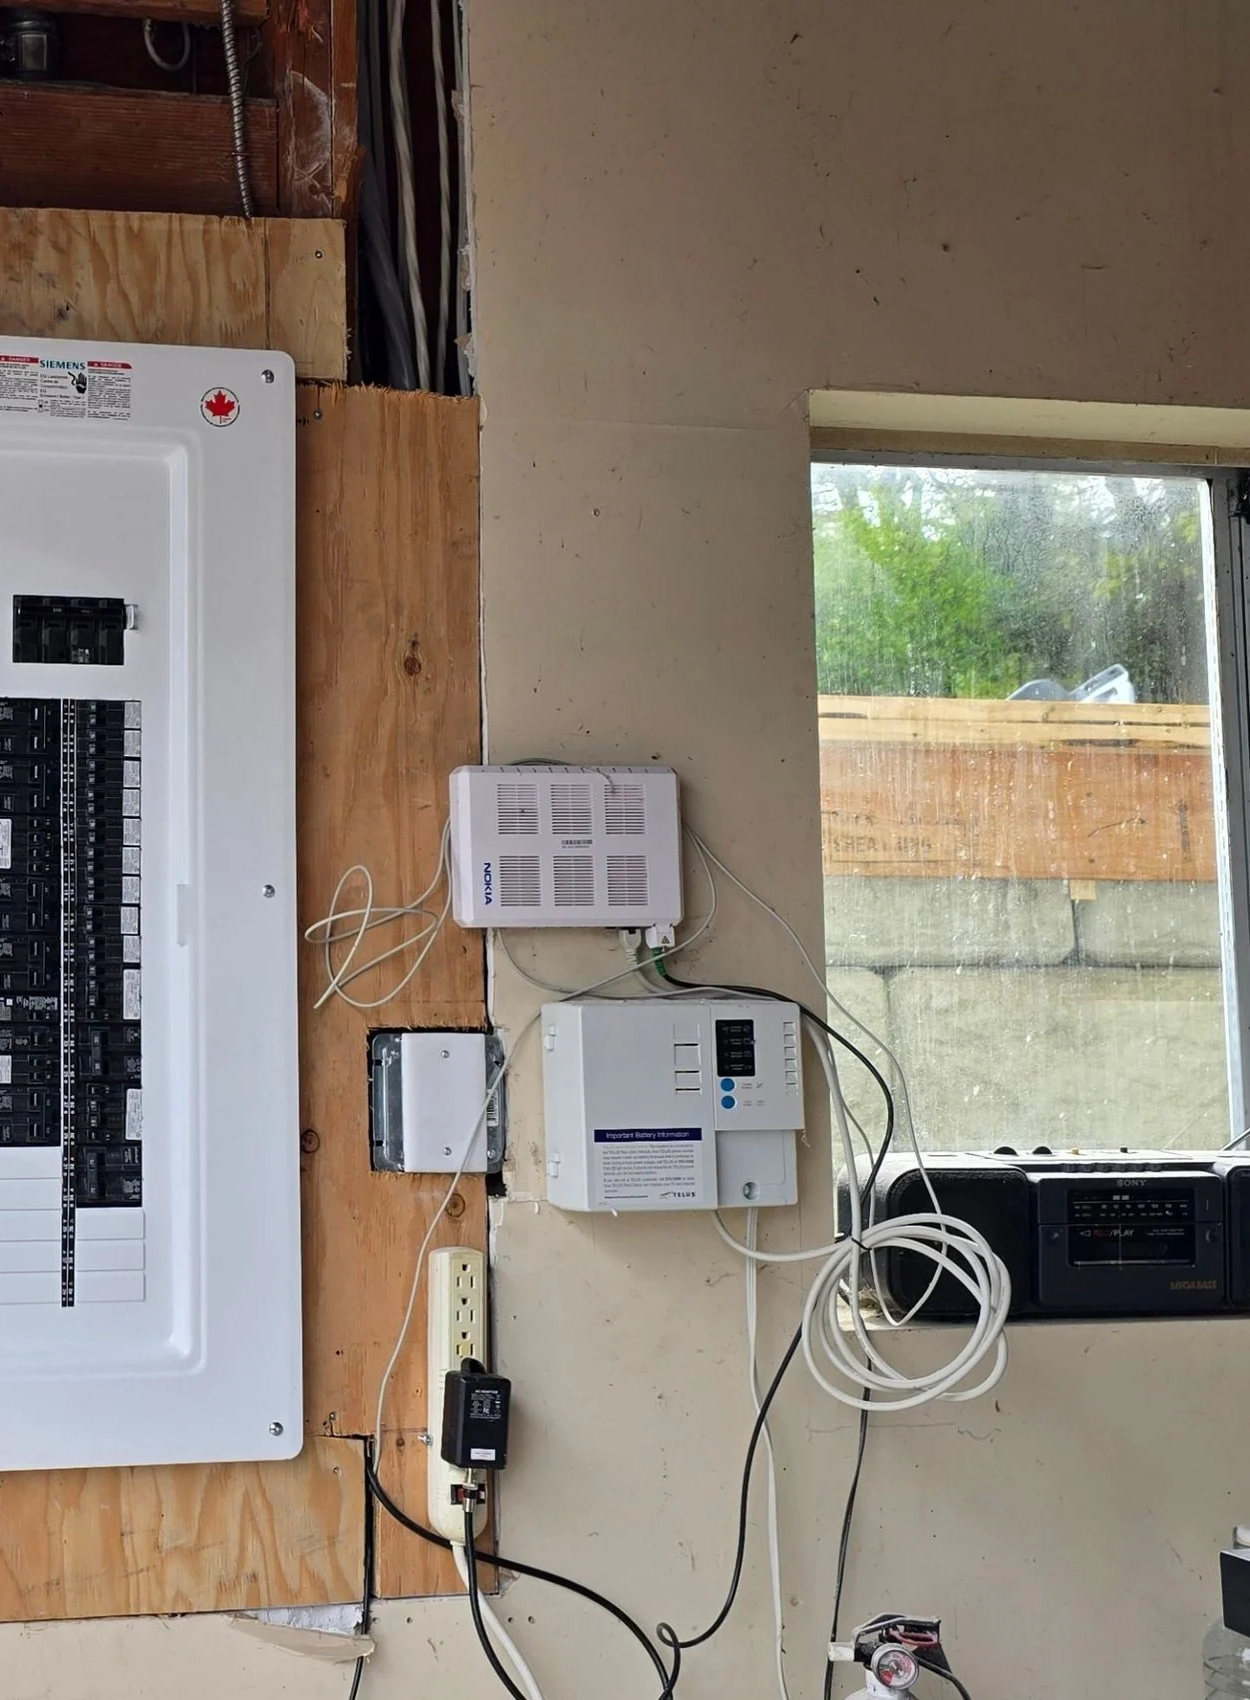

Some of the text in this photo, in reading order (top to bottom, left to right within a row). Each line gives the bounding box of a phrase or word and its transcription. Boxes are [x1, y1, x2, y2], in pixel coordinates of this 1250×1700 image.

[39, 359, 86, 370] SIEMENS
[483, 862, 492, 905] NOKIA
[635, 1131, 656, 1139] Battery
[1116, 1179, 1147, 1187] SONY
